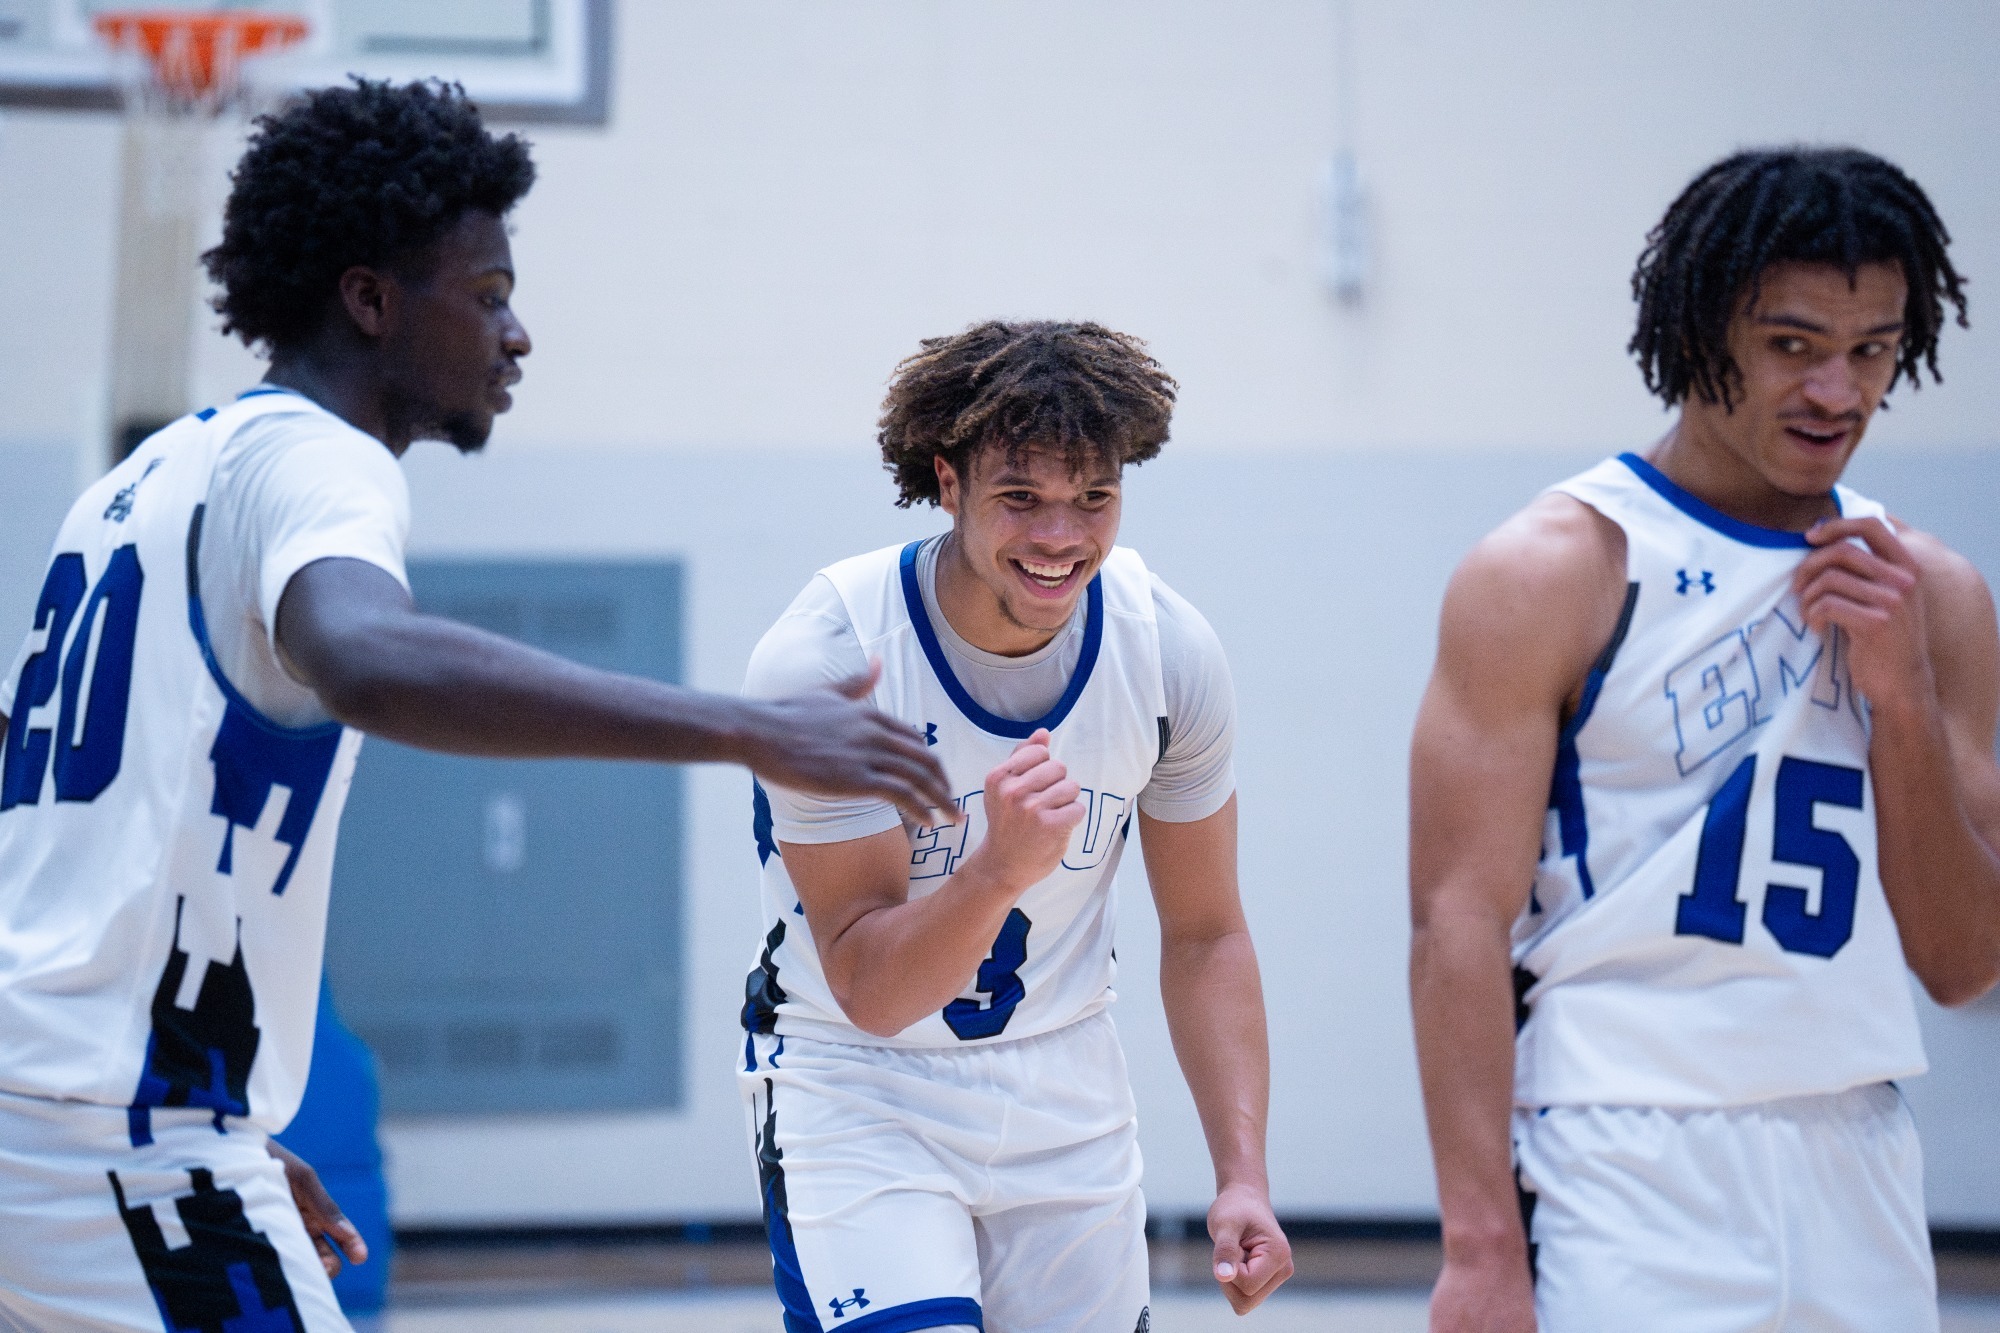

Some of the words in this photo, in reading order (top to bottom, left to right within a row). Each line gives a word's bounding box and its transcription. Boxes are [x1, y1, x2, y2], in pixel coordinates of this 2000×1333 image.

[0, 543, 144, 812] 20
[1664, 608, 1872, 778] EM
[1675, 752, 1864, 959] 15
[942, 907, 1032, 1041] 3
